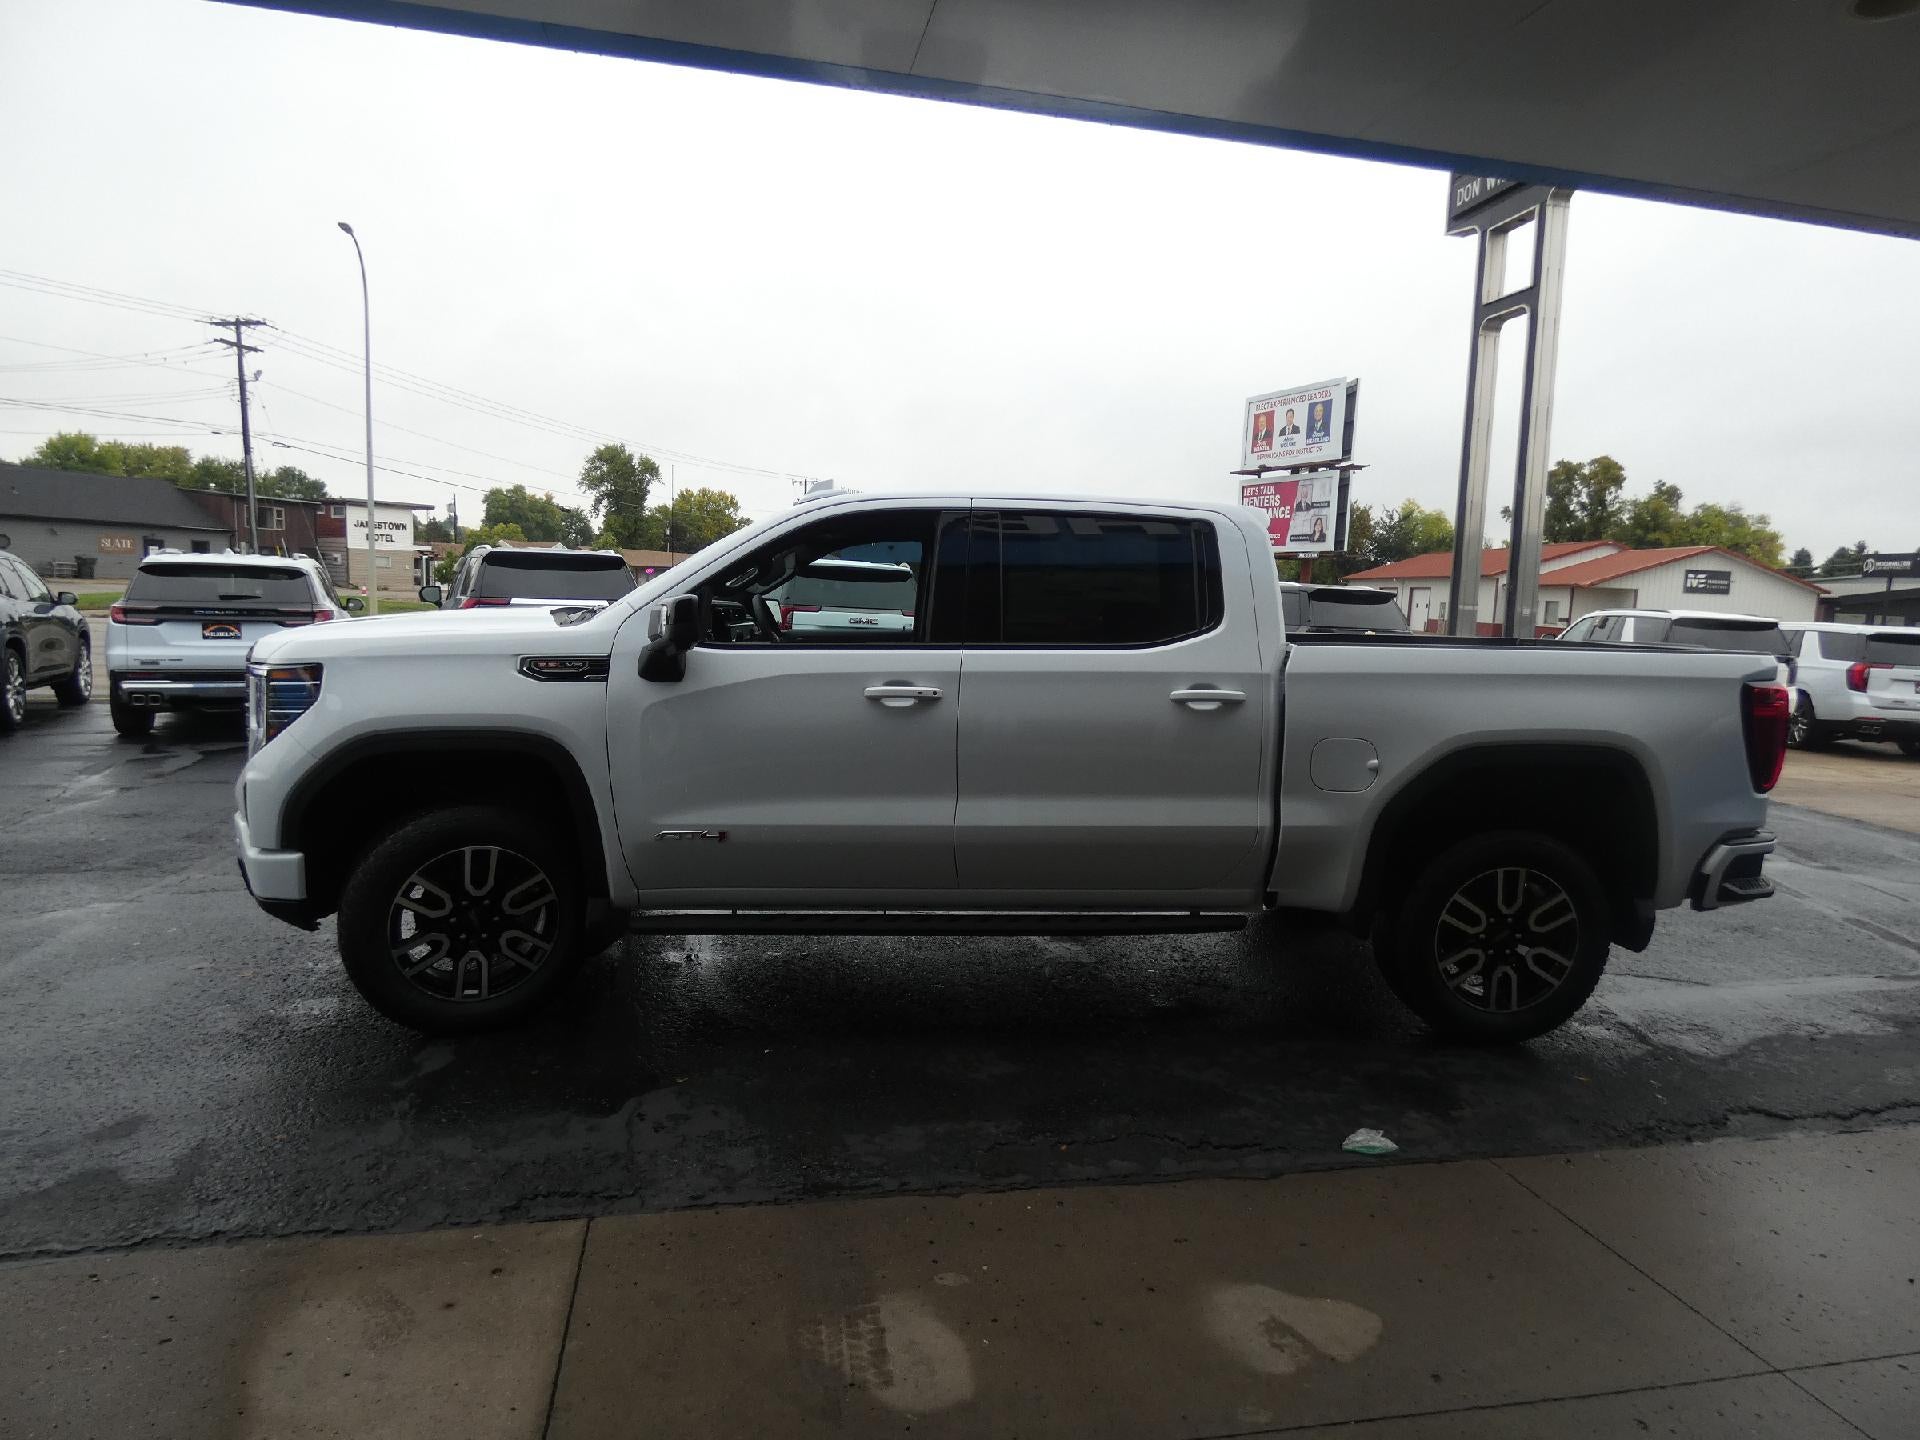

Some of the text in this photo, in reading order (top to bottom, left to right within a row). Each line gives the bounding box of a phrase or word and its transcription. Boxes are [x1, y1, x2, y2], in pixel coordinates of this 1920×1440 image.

[1456, 178, 1481, 206] DON
[1308, 389, 1332, 401] LEADERS
[1243, 485, 1275, 496] LET'S TALK
[1243, 494, 1281, 507] RENTERS
[353, 520, 407, 531] JAESTOWN
[100, 537, 133, 549] SLATE
[365, 533, 396, 543] OTEL
[849, 617, 879, 625] GMC
